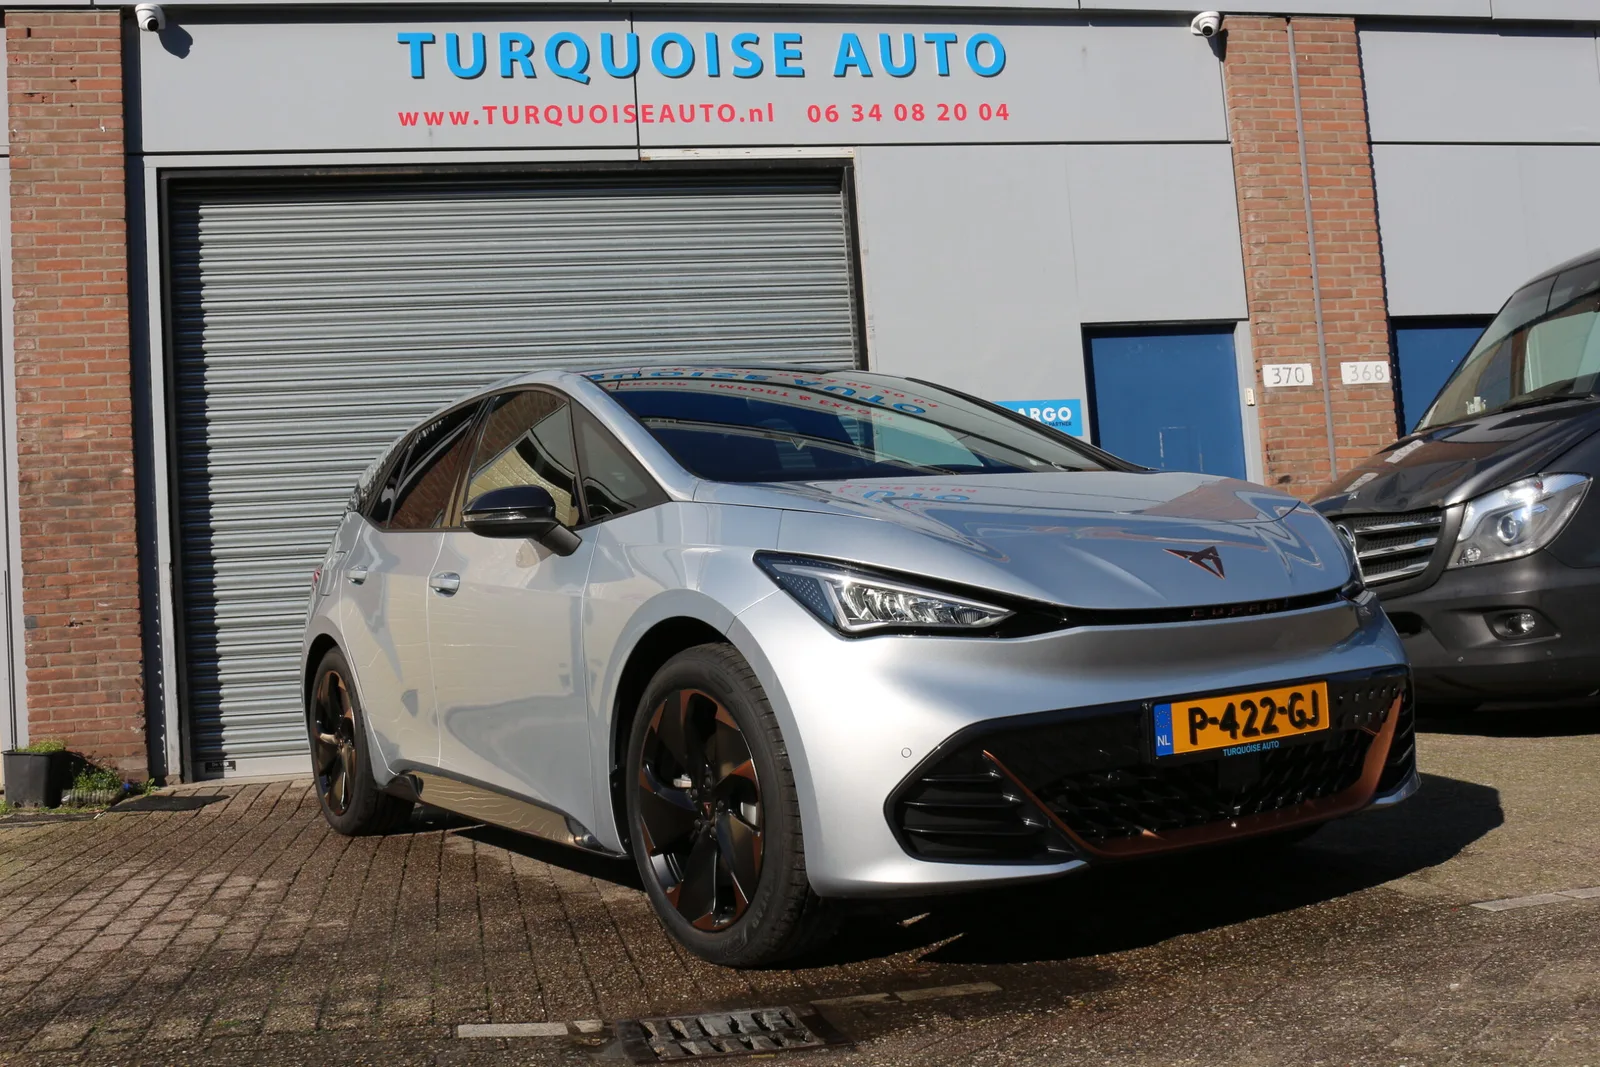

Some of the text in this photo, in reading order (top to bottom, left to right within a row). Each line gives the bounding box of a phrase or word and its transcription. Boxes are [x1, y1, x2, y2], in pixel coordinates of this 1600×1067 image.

[397, 31, 1007, 85] TURQUOISE AUTO
[398, 102, 1010, 127] www.TURQUOISEAUTO.nl 06 34 08 20 04
[1271, 366, 1305, 385] 370
[1349, 364, 1385, 383] 368
[1017, 406, 1072, 422] ARGO
[1188, 690, 1320, 745] P-422-GJ
[1157, 735, 1171, 747] NL
[1222, 740, 1280, 757] TURQUOISE AUTO
